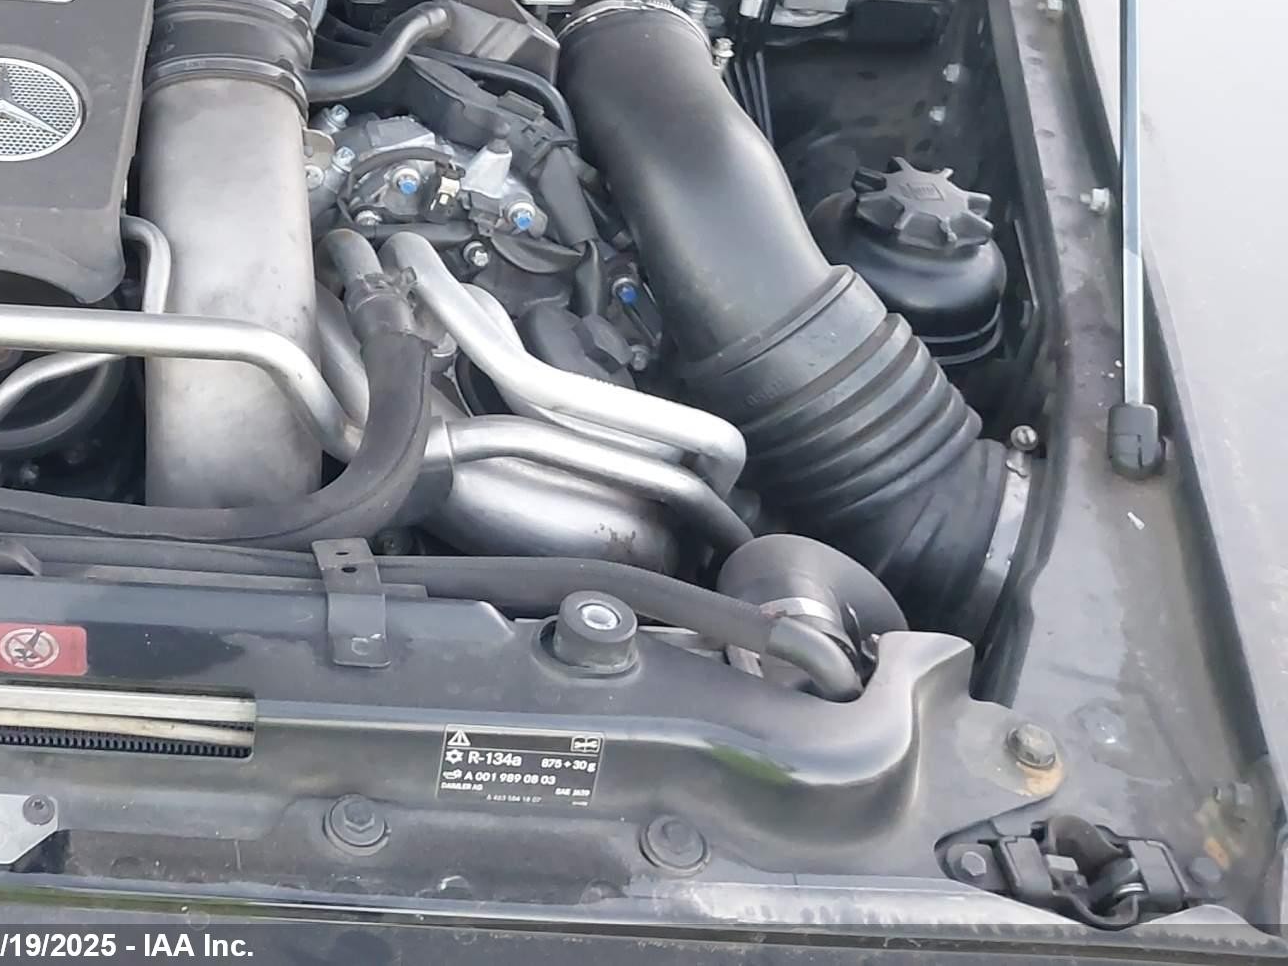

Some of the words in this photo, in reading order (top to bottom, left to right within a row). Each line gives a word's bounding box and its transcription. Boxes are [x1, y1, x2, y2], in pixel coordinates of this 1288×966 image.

[467, 750, 522, 766] R-134a
[541, 758, 562, 769] 875
[572, 760, 587, 770] 30
[464, 771, 473, 781] A
[475, 772, 496, 782] 001
[499, 773, 522, 784] 989
[523, 774, 539, 784] 08
[540, 775, 556, 785] 03
